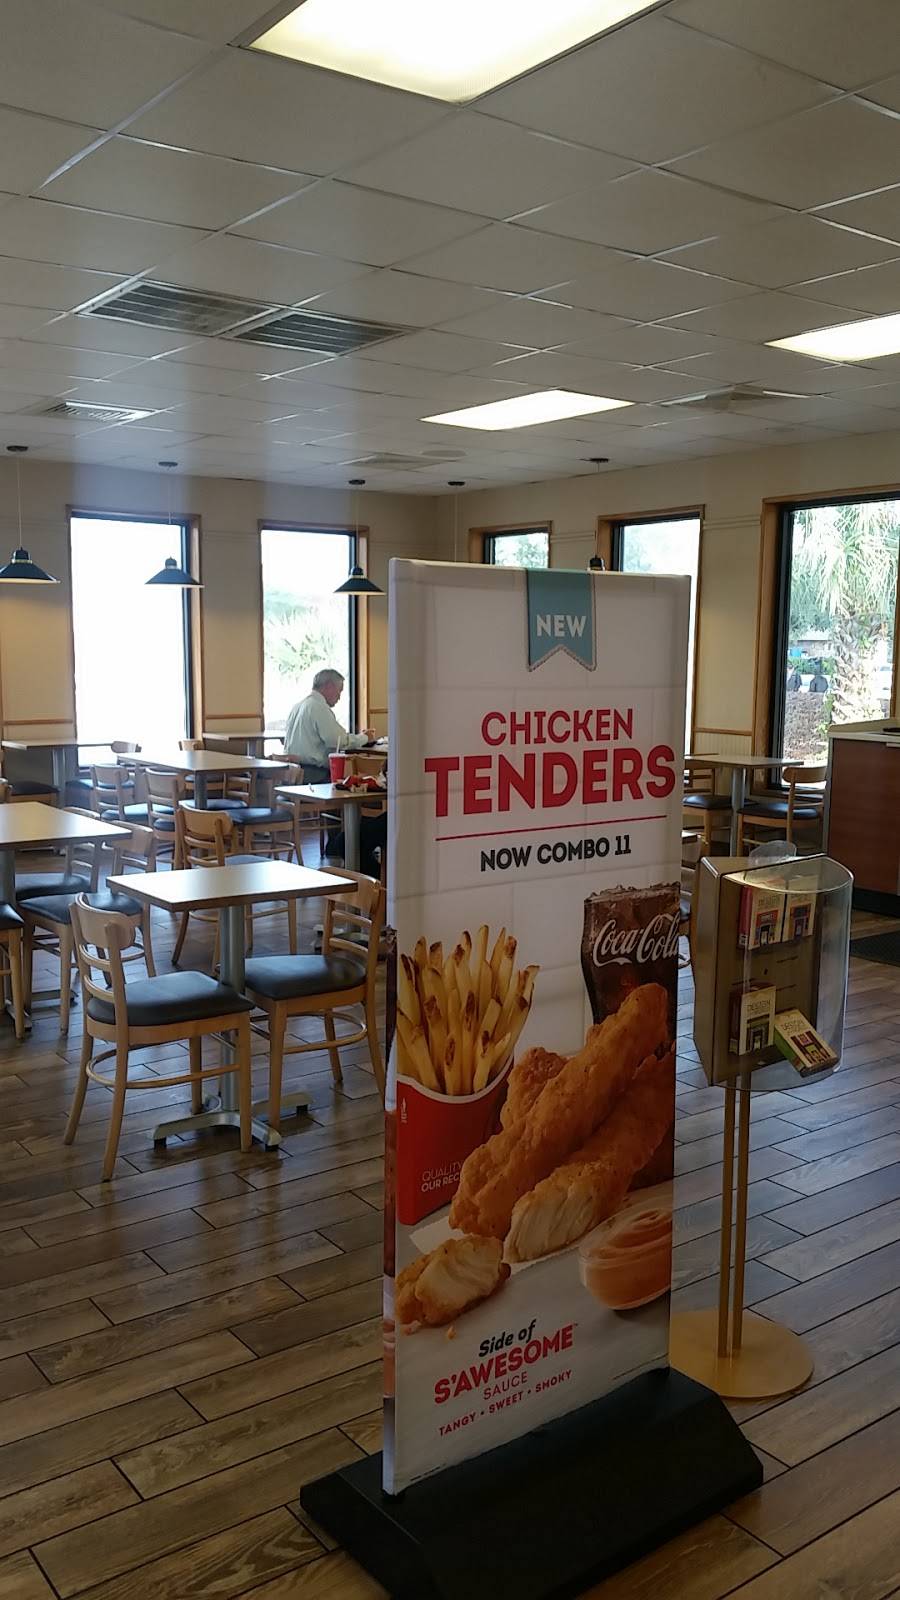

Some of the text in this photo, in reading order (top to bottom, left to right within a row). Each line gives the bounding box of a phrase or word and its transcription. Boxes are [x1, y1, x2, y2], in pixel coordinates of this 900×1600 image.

[536, 614, 586, 637] NEW
[481, 708, 633, 746] CHICKEN
[424, 745, 676, 817] TENDERS
[480, 835, 632, 872] NOW COMBO 11
[421, 1178, 442, 1192] OUR
[479, 1319, 536, 1357] Side of
[439, 1369, 572, 1436] TANGY SWEET SMOKY
[483, 1371, 528, 1400] SAUCE
